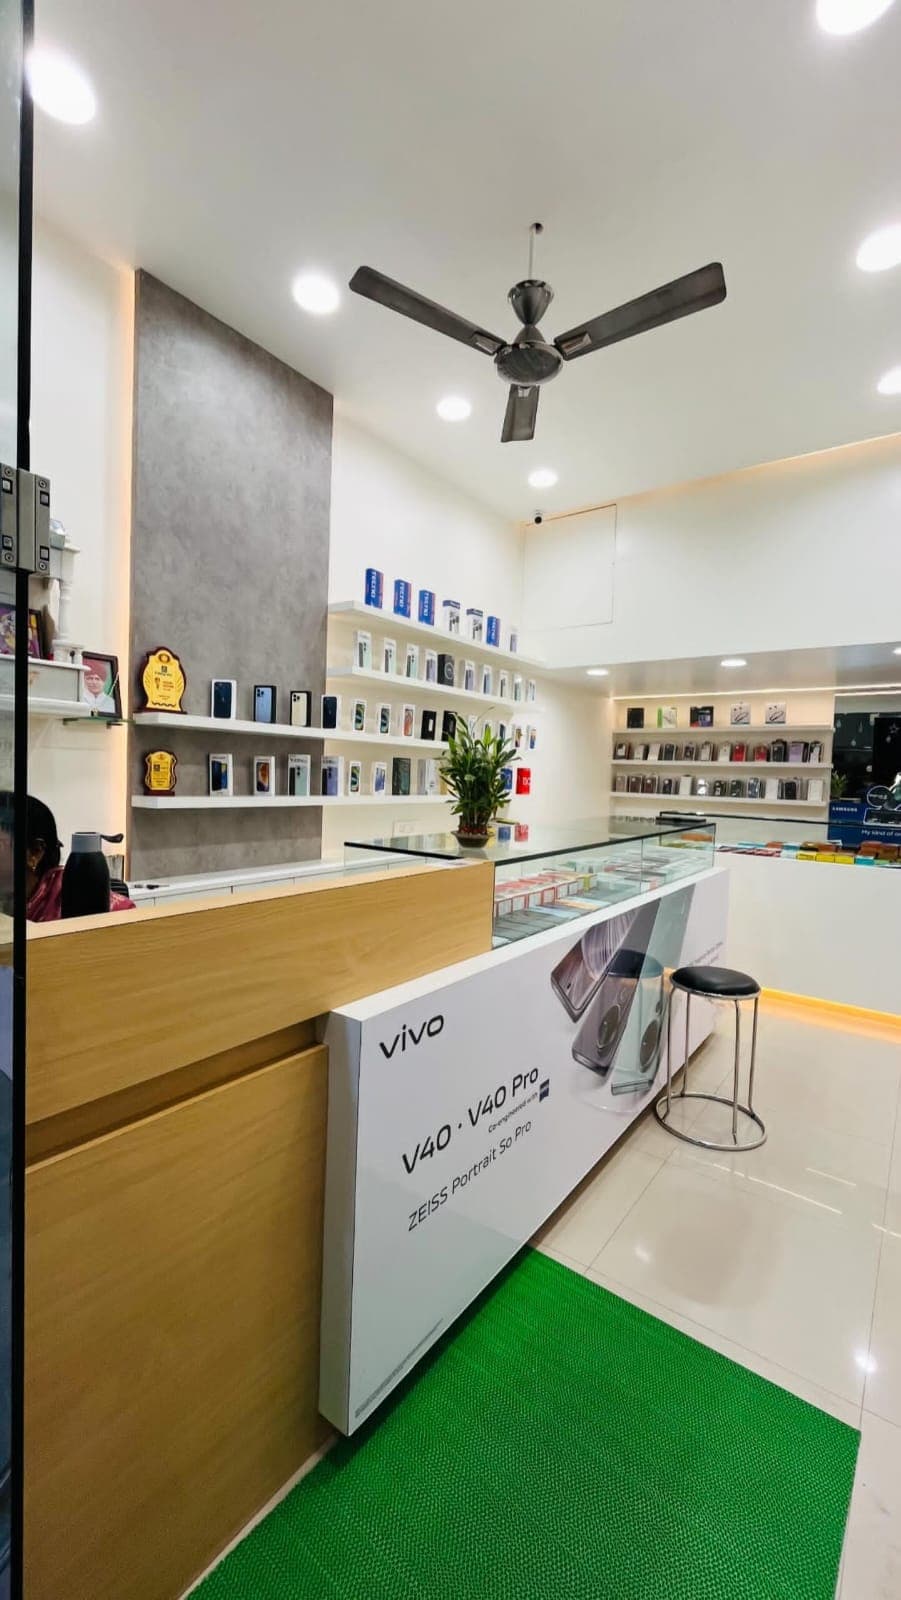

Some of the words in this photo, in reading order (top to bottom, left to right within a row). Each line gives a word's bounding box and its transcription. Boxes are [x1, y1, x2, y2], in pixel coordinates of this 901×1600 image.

[379, 1014, 445, 1059] vivo
[402, 1124, 451, 1174] V40
[468, 1085, 507, 1127] V40
[512, 1067, 539, 1098] Pro
[408, 1186, 448, 1232] ZEISS
[451, 1148, 498, 1195] Portrait
[499, 1136, 513, 1155] So
[515, 1120, 532, 1142] Pro
